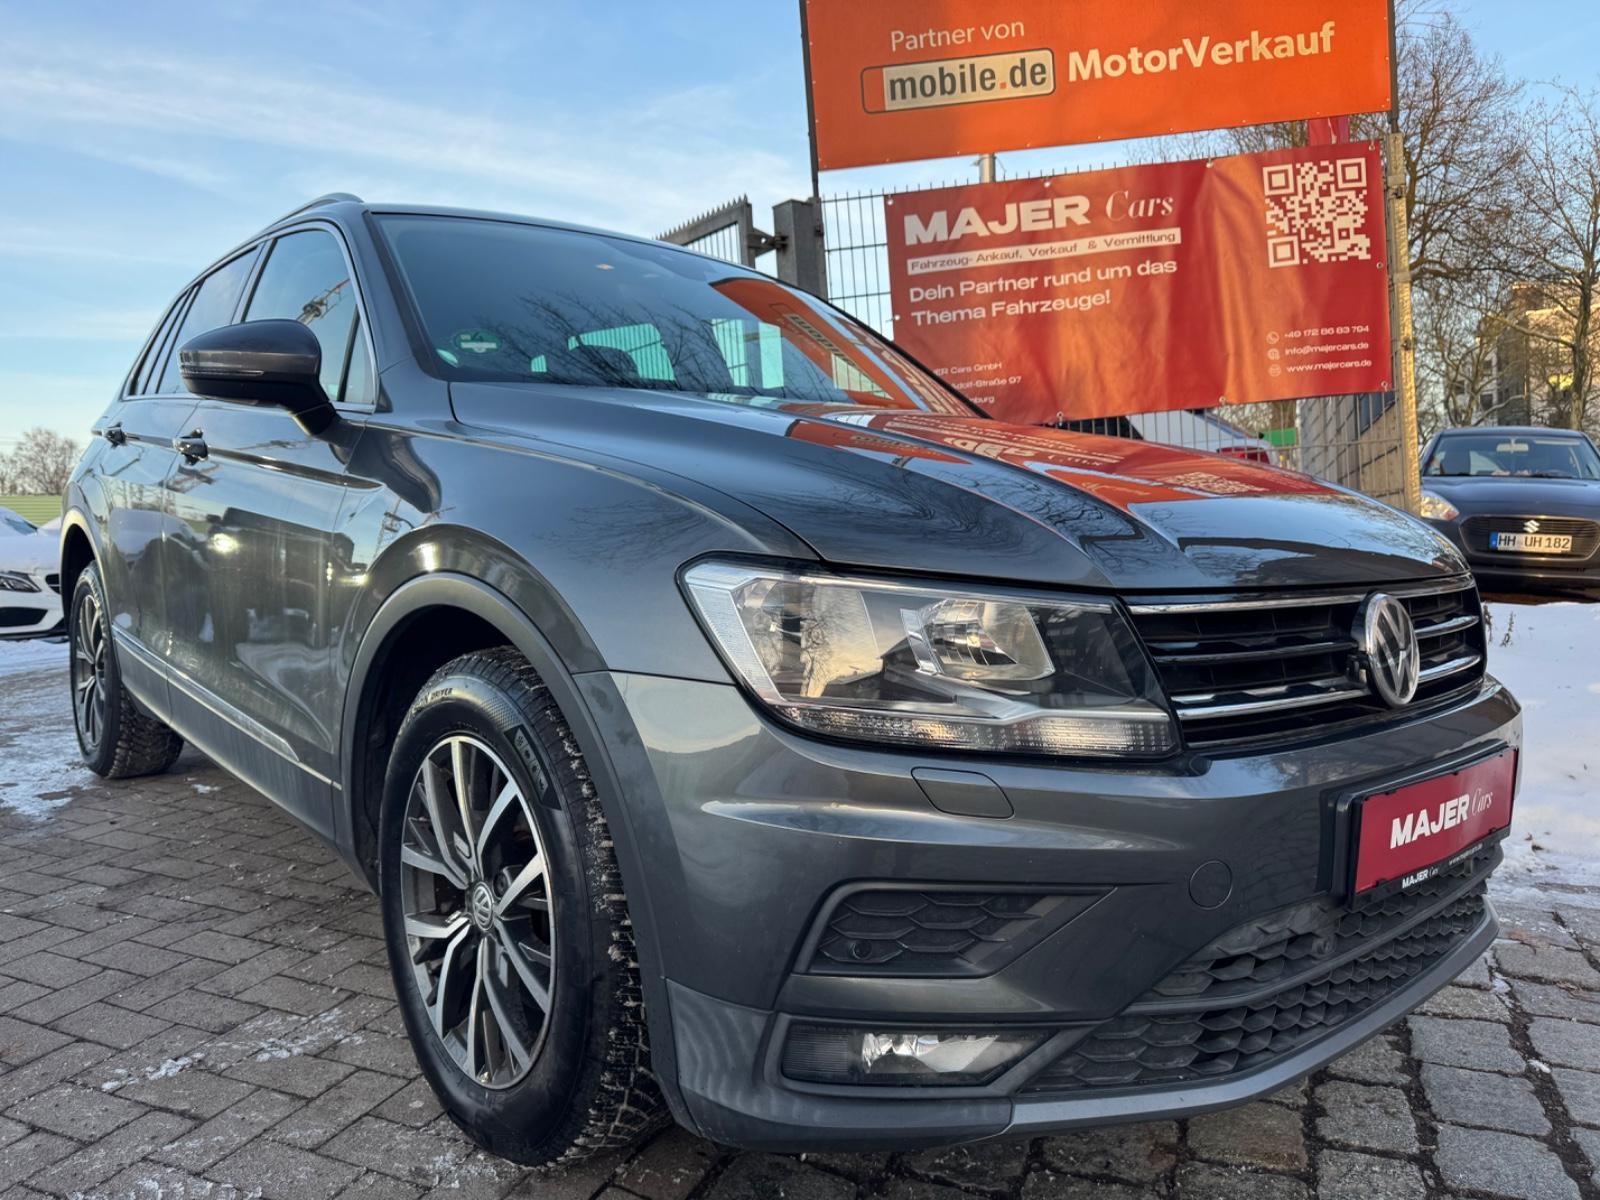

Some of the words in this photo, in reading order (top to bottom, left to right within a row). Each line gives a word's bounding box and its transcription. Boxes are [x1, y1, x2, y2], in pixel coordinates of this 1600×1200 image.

[891, 27, 975, 51] Partner
[980, 21, 1025, 41] von
[1068, 21, 1335, 82] MotorVerkauf
[889, 57, 1047, 101] mobile.de
[903, 195, 1092, 246] MAJER
[1105, 190, 1174, 221] Cars
[1029, 243, 1078, 257] Verkauf
[1088, 240, 1097, 250] &
[1104, 233, 1176, 248] Vermittlung
[910, 284, 954, 303] Dein
[960, 277, 1038, 296] Partner
[1043, 267, 1091, 288] rund
[1097, 265, 1132, 280] um
[1137, 260, 1177, 276] das
[911, 307, 986, 326] Thema
[992, 289, 1110, 317] Fahrzeuge!
[1285, 342, 1369, 355] info@majercars.de
[951, 366, 972, 374] Cars
[973, 363, 1002, 372] GmbH
[1286, 359, 1372, 373] www.majercars.de
[1498, 535, 1516, 546] HH
[1545, 537, 1570, 549] 182
[1390, 794, 1470, 849] MAJER
[1471, 787, 1493, 816] Cars
[1402, 868, 1429, 889] MAJER
